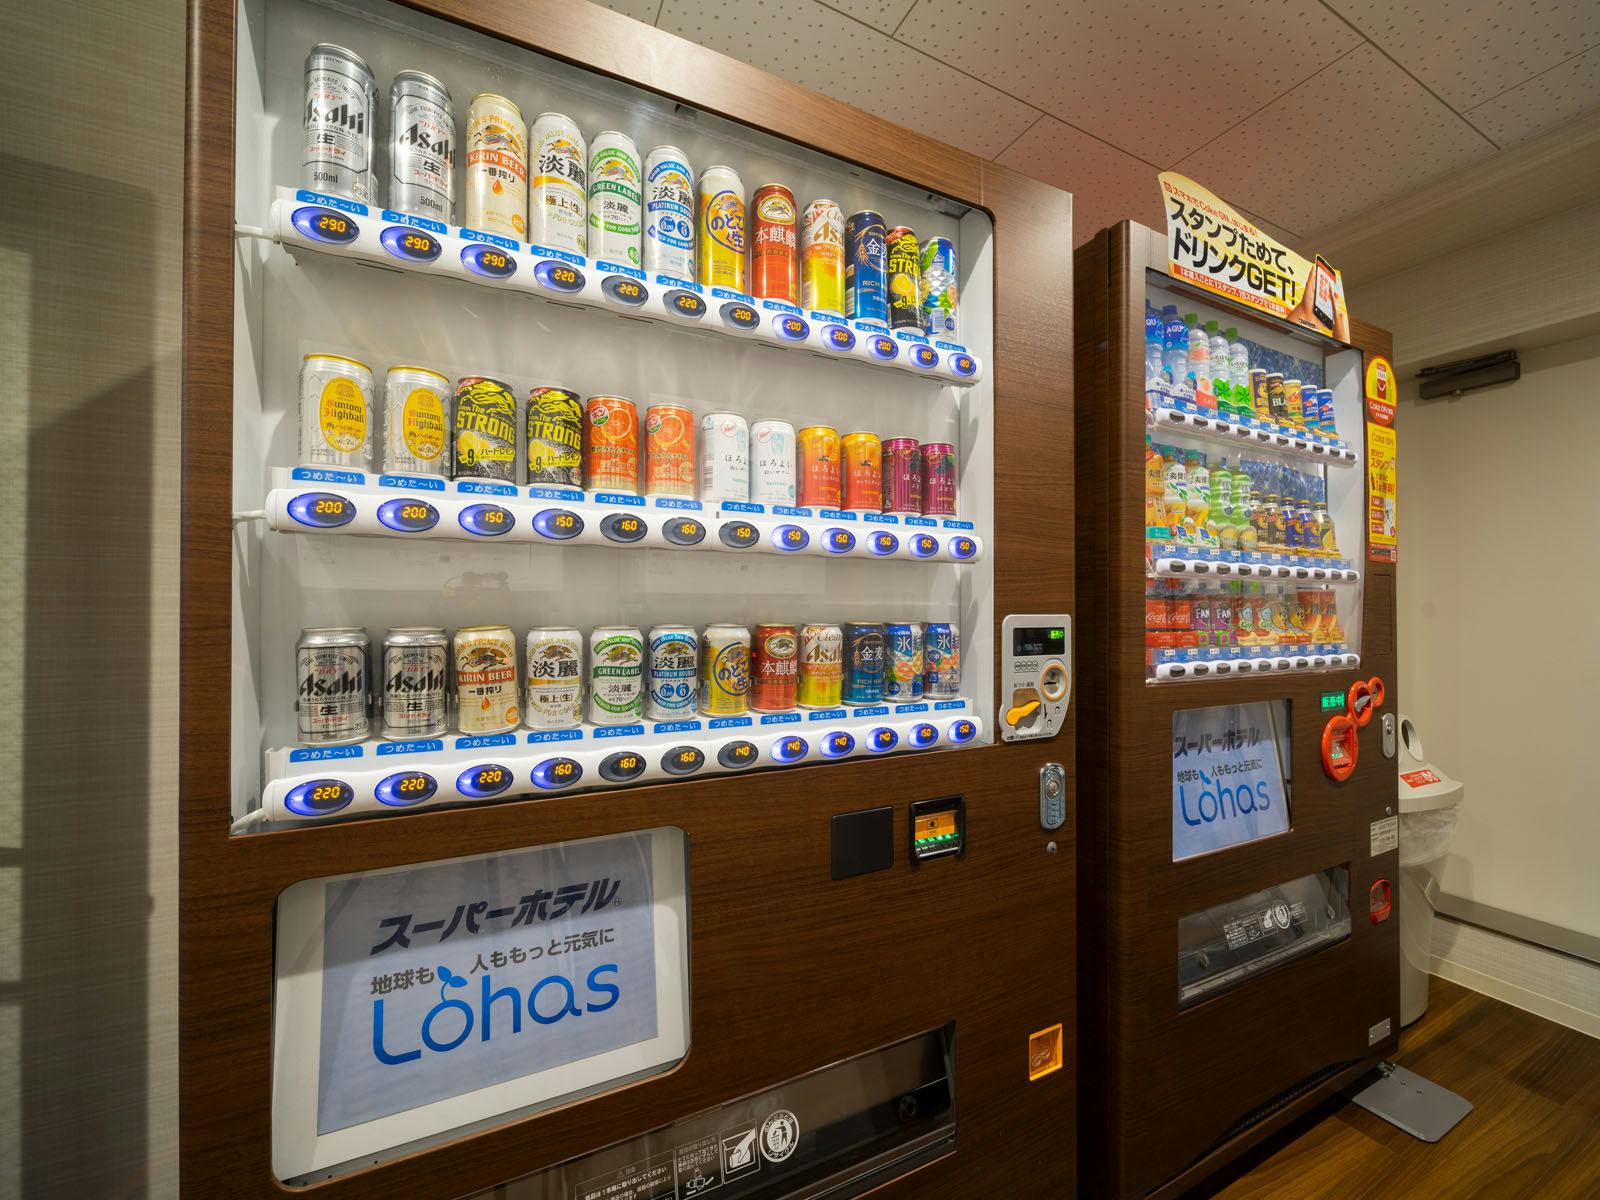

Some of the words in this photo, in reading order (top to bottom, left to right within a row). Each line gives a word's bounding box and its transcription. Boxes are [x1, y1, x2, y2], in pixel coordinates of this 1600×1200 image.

[304, 99, 364, 134] Asahi
[399, 123, 456, 169] Asahi
[424, 161, 441, 176] 生
[469, 152, 499, 166] KIRIN
[501, 157, 526, 178] BEER
[538, 154, 586, 189] 淡麗
[313, 171, 338, 184] 500ml
[481, 167, 516, 183] 一番搾り
[593, 182, 617, 193] GREEN
[618, 186, 639, 200] LABEL
[420, 195, 443, 213] 500ml
[603, 200, 629, 213] 淡麗
[319, 217, 346, 233] 290
[755, 225, 797, 249] 本麒麟
[1170, 197, 1295, 275] スタンプためて、
[405, 236, 430, 251] 290
[483, 253, 506, 268] 290
[1173, 227, 1296, 305] ドリンクGET!
[554, 269, 575, 283] 220
[619, 283, 639, 296] 220
[679, 297, 697, 309] 220
[734, 309, 752, 321] 200
[786, 320, 801, 332] 200
[326, 399, 362, 414] Suntory
[1272, 397, 1287, 407] BLA
[324, 407, 364, 424] Highball
[408, 409, 441, 423] Suntory
[407, 418, 443, 432] Highball
[457, 410, 516, 446] STRONG
[527, 420, 581, 450] STRONG
[480, 446, 514, 456] ハードレモン
[547, 452, 580, 462] ハードレモン
[316, 501, 343, 514] 200
[402, 506, 427, 519] 200
[484, 512, 504, 523] 150
[555, 516, 573, 528] 150
[621, 520, 637, 531] 160
[681, 524, 696, 535] 160
[736, 527, 751, 538] 150
[787, 531, 801, 542] 150
[1195, 608, 1210, 619] FAN
[1216, 608, 1232, 620] FAN
[860, 645, 884, 661] 金麦
[532, 660, 579, 678] 淡麗
[654, 656, 695, 669] 淡麗
[761, 660, 797, 676] 本麒麟
[458, 672, 485, 682] KIRIN
[488, 669, 512, 681] BEER
[598, 668, 621, 676] GREEN
[622, 666, 641, 675] LABEL
[300, 669, 362, 697] Asahi
[386, 669, 443, 697] Asahi
[608, 683, 632, 693] 淡麗
[468, 685, 502, 696] 一番搾り
[319, 704, 339, 716] 生
[406, 701, 424, 712] 生
[787, 741, 801, 751] 140
[1174, 727, 1260, 759] スーパーホテル
[680, 752, 695, 762] 160
[735, 746, 750, 756] 140
[554, 763, 572, 775] 160
[620, 757, 636, 769] 160
[479, 770, 502, 783] 220
[1177, 769, 1199, 783] 地球も
[1210, 759, 1263, 778] 人ももっと元気に
[400, 778, 425, 791] 220
[313, 786, 340, 800] 220
[1179, 778, 1271, 827] Lohas
[369, 878, 622, 956] スーパーホテル
[370, 966, 435, 996] 地球も
[469, 927, 615, 975] 人ももっと元気に
[372, 963, 621, 1066] Lohas
